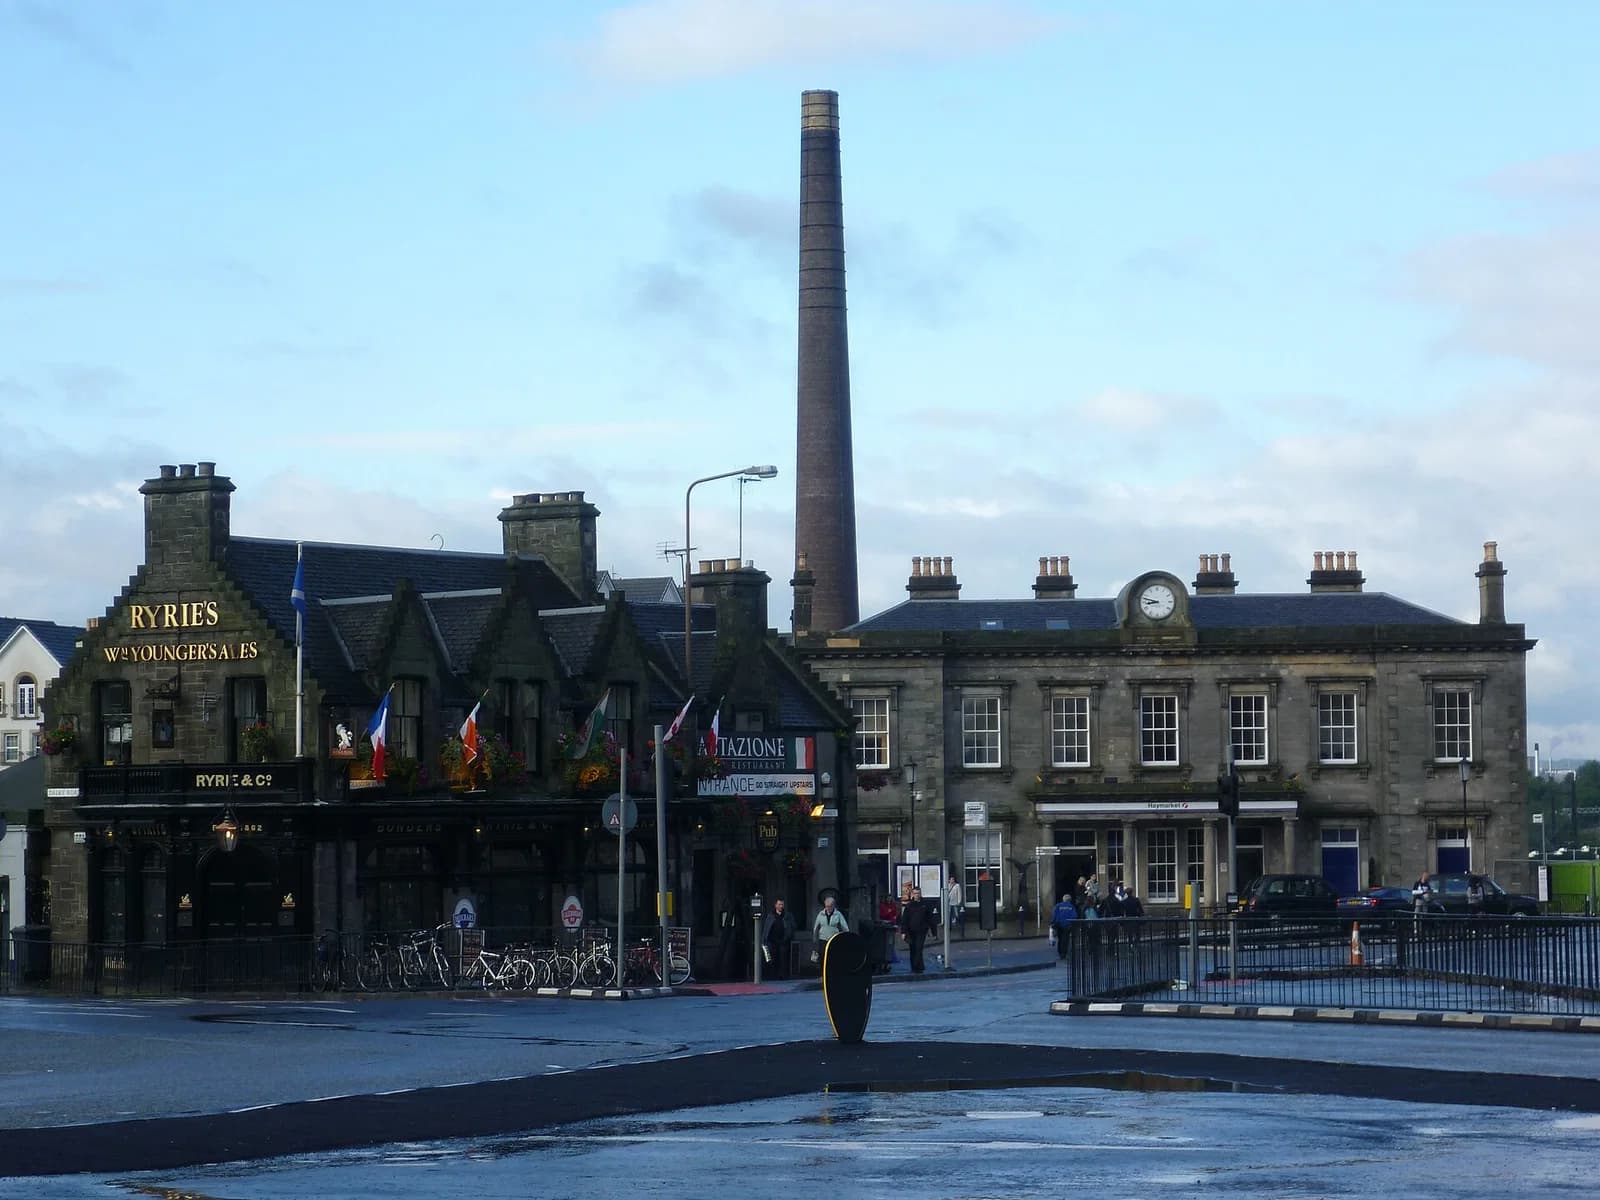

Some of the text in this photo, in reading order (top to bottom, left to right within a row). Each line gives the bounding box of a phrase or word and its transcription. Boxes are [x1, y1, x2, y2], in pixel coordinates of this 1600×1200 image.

[130, 601, 219, 629] RYRIE'S
[130, 643, 217, 662] YOUNGER'S
[218, 641, 258, 660] ALES
[712, 736, 785, 757] TAZIONE
[196, 774, 239, 787] RYRIE
[240, 774, 253, 786] &
[699, 777, 814, 792] NTRANCE GO STRAIGHT UPSTAIRS
[760, 824, 777, 838] Pub
